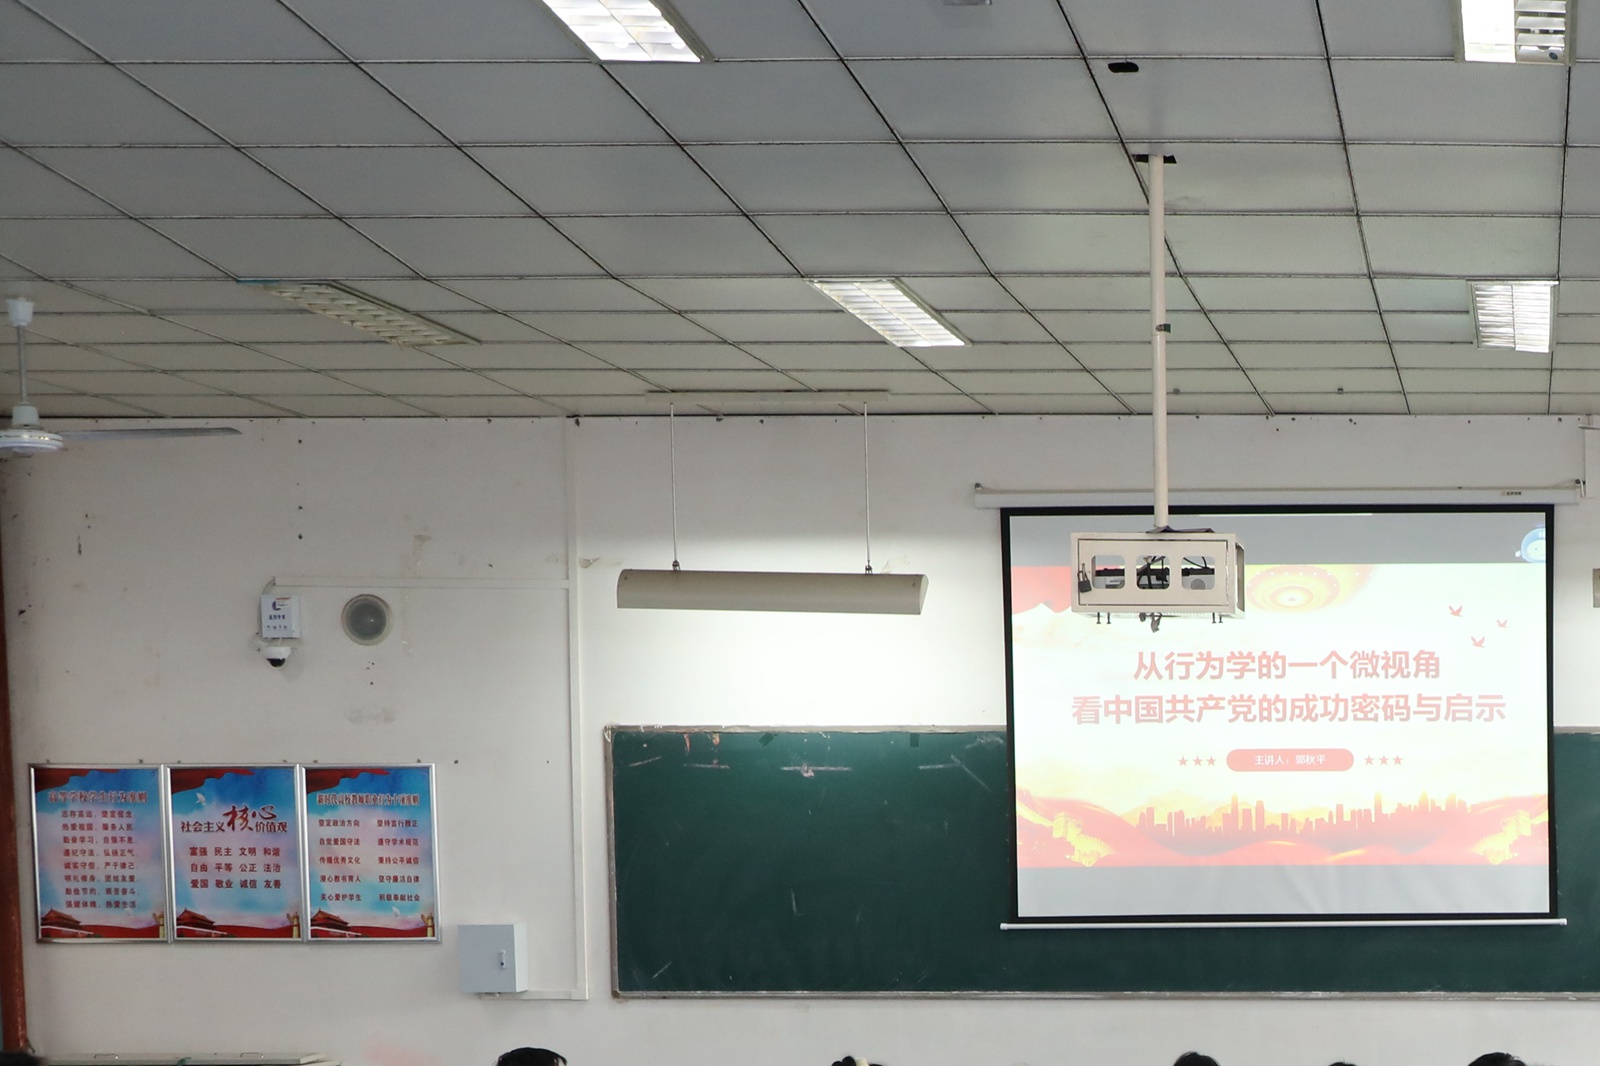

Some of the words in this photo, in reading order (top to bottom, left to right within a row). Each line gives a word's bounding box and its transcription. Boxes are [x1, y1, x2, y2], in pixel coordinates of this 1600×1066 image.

[1133, 649, 1440, 681] 从行为学的一个微视角
[1071, 693, 1507, 726] 看中国共产党的成功密码与启示
[189, 847, 208, 857] 富强
[214, 847, 232, 857] 民主
[239, 847, 257, 857] 文明
[263, 847, 281, 857] 和谐
[190, 863, 208, 873] 自由
[214, 863, 233, 873] 平等
[239, 863, 257, 873] 公正
[263, 863, 281, 873] 法治
[190, 879, 208, 889] 爱国
[215, 879, 233, 889] 敬业
[240, 879, 258, 889] 诚信
[264, 879, 282, 889] 友善
